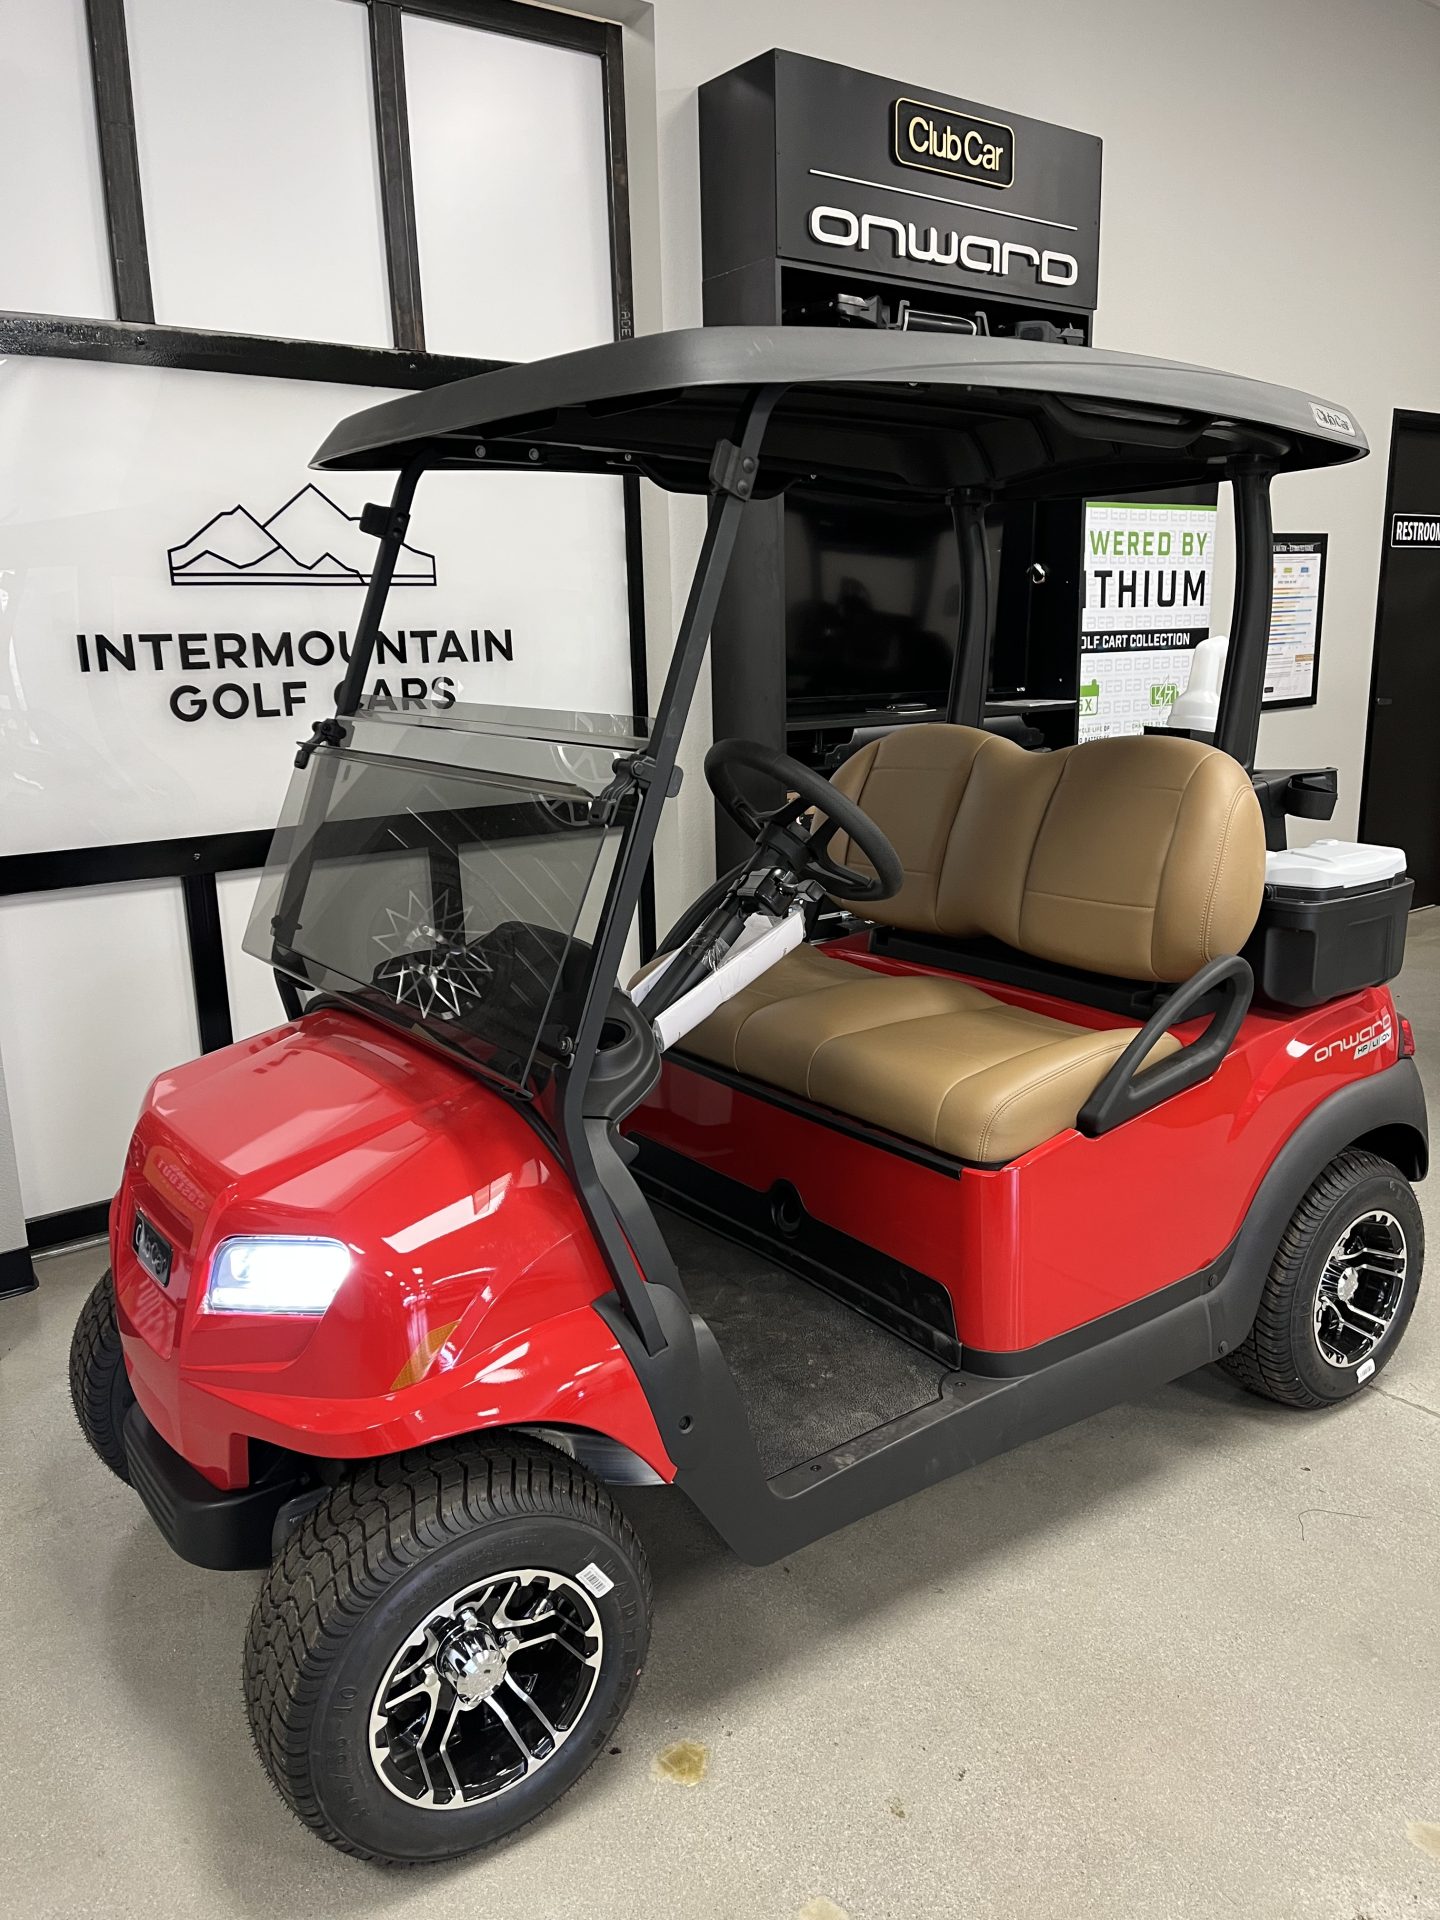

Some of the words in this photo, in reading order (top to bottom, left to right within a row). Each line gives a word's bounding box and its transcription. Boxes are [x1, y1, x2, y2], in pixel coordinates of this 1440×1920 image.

[1089, 530, 1171, 556] WERED
[1182, 532, 1208, 556] BY
[1102, 634, 1128, 648] CART
[1129, 632, 1190, 647] COLLECTION
[169, 680, 307, 723] GOLF
